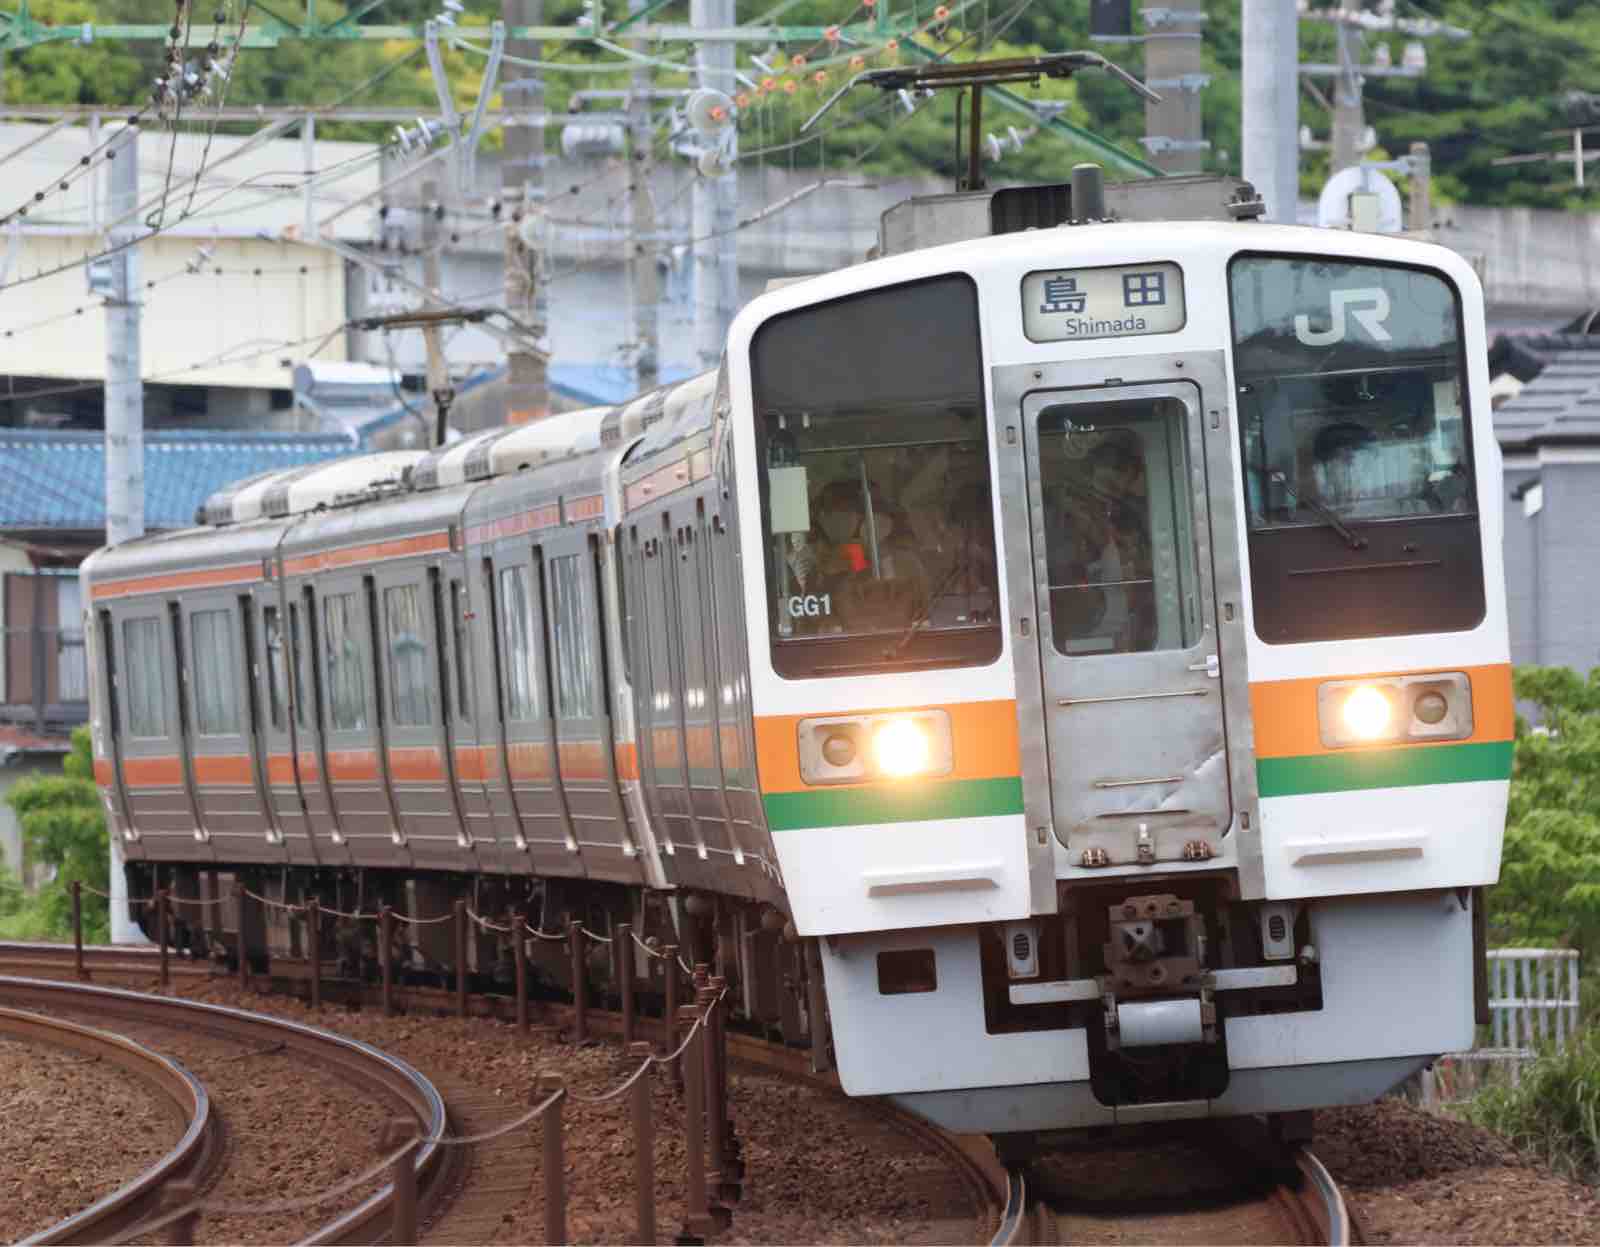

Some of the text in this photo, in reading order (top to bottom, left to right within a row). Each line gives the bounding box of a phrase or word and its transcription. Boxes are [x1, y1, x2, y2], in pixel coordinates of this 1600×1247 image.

[1040, 272, 1166, 314] 島田
[1066, 314, 1146, 335] Shimada
[1294, 287, 1392, 346] JR
[788, 594, 832, 616] GG1
